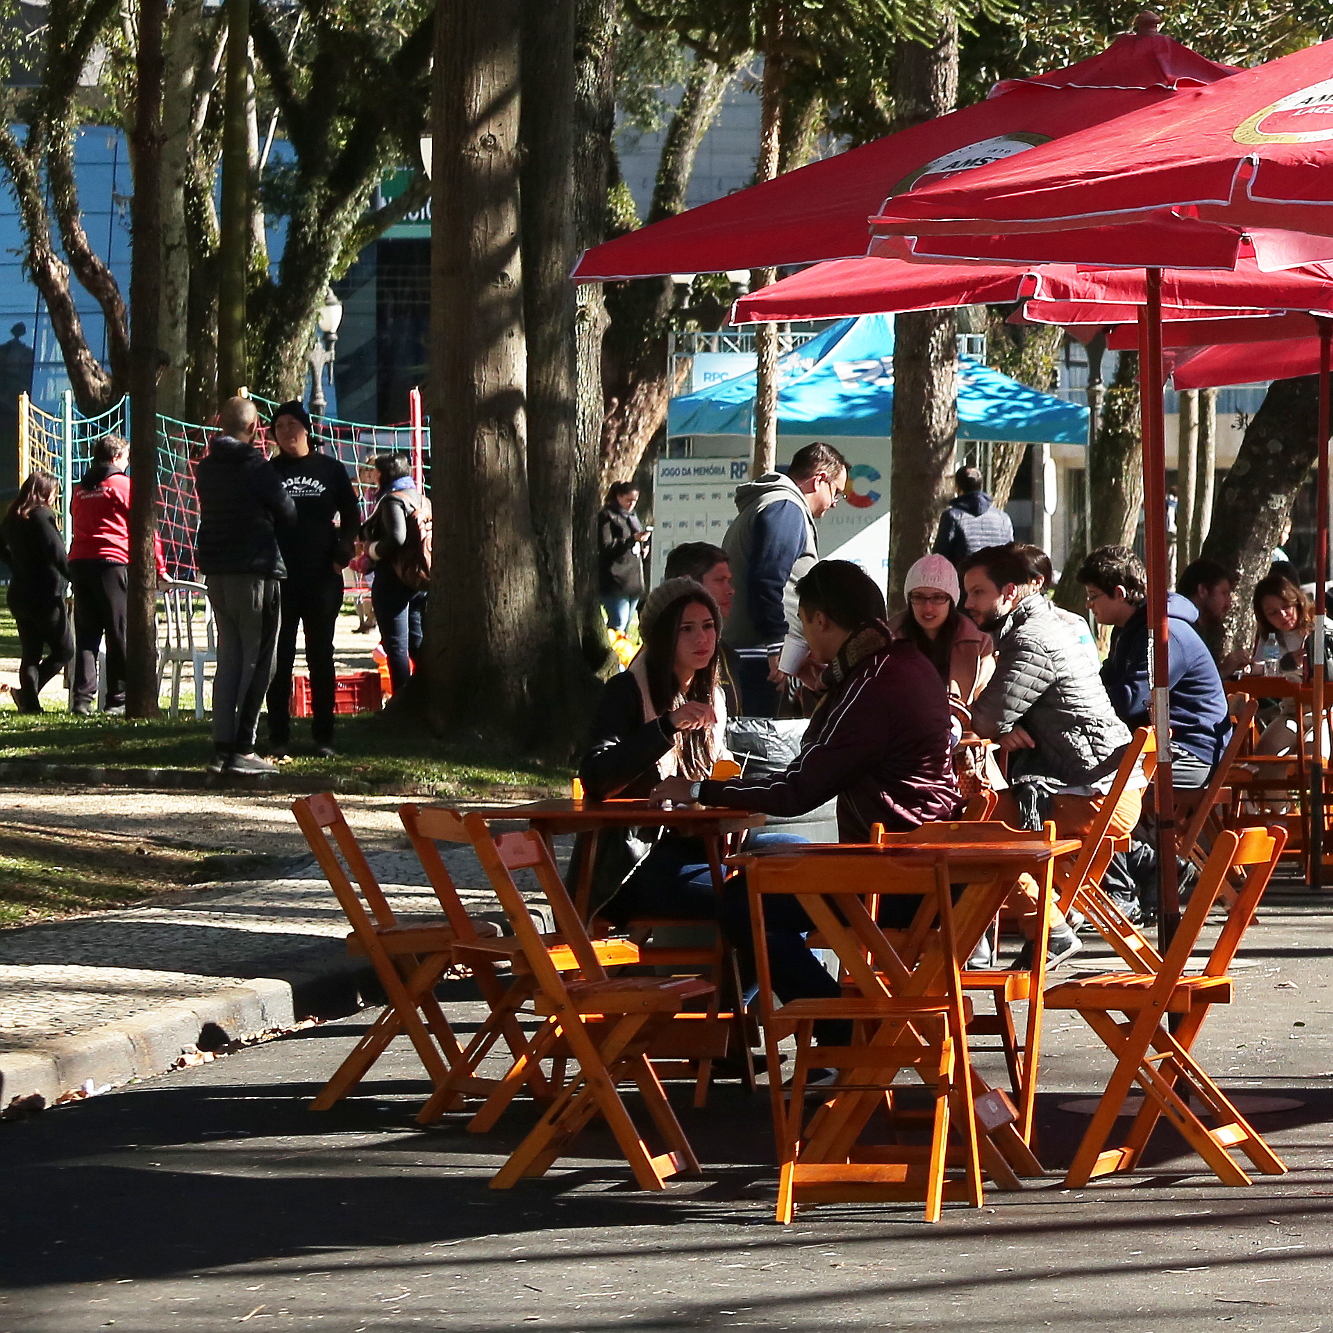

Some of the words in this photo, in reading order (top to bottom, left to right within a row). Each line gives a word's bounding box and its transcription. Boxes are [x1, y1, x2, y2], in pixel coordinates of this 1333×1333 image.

[940, 156, 1001, 171] AMS
[660, 466, 680, 478] JOGO
[682, 466, 692, 476] DA
[730, 461, 748, 480] RP
